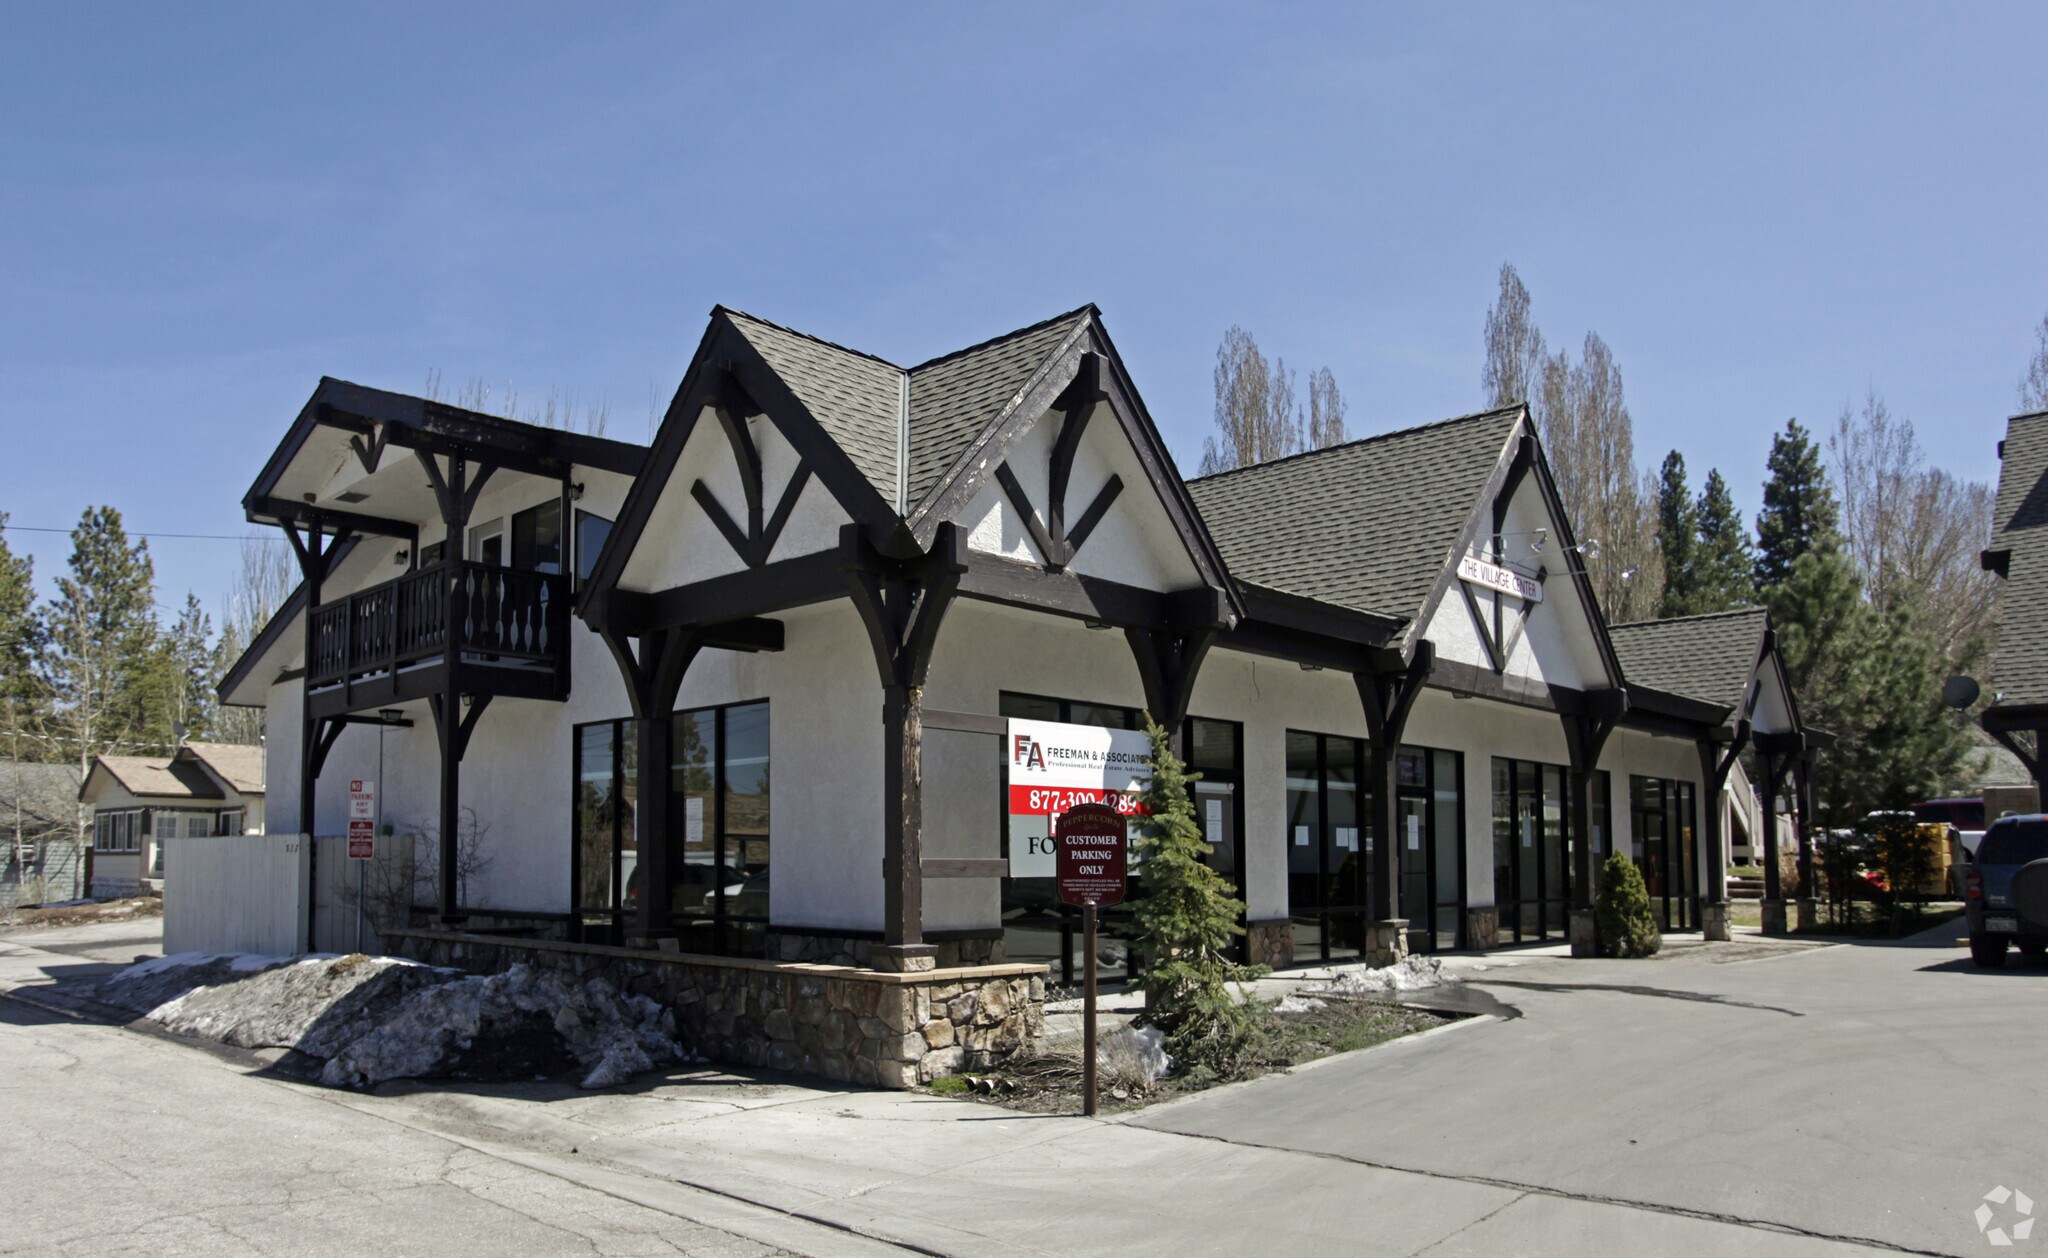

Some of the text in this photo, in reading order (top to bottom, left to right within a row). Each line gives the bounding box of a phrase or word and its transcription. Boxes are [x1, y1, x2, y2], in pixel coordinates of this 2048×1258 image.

[1464, 560, 1537, 597] THE VILLAGE CENTER
[1014, 734, 1046, 771] FA
[1047, 747, 1150, 765] FREEMAN & ASSOCIATE
[1048, 761, 1086, 769] Professional
[1088, 762, 1102, 770] Real
[1104, 763, 1122, 771] Estate
[352, 782, 361, 790] NO
[1063, 814, 1120, 828] PEPPERCORN
[1065, 835, 1117, 845] CUSTOMER
[1071, 850, 1112, 860] PARKING
[1079, 865, 1104, 875] ONLY
